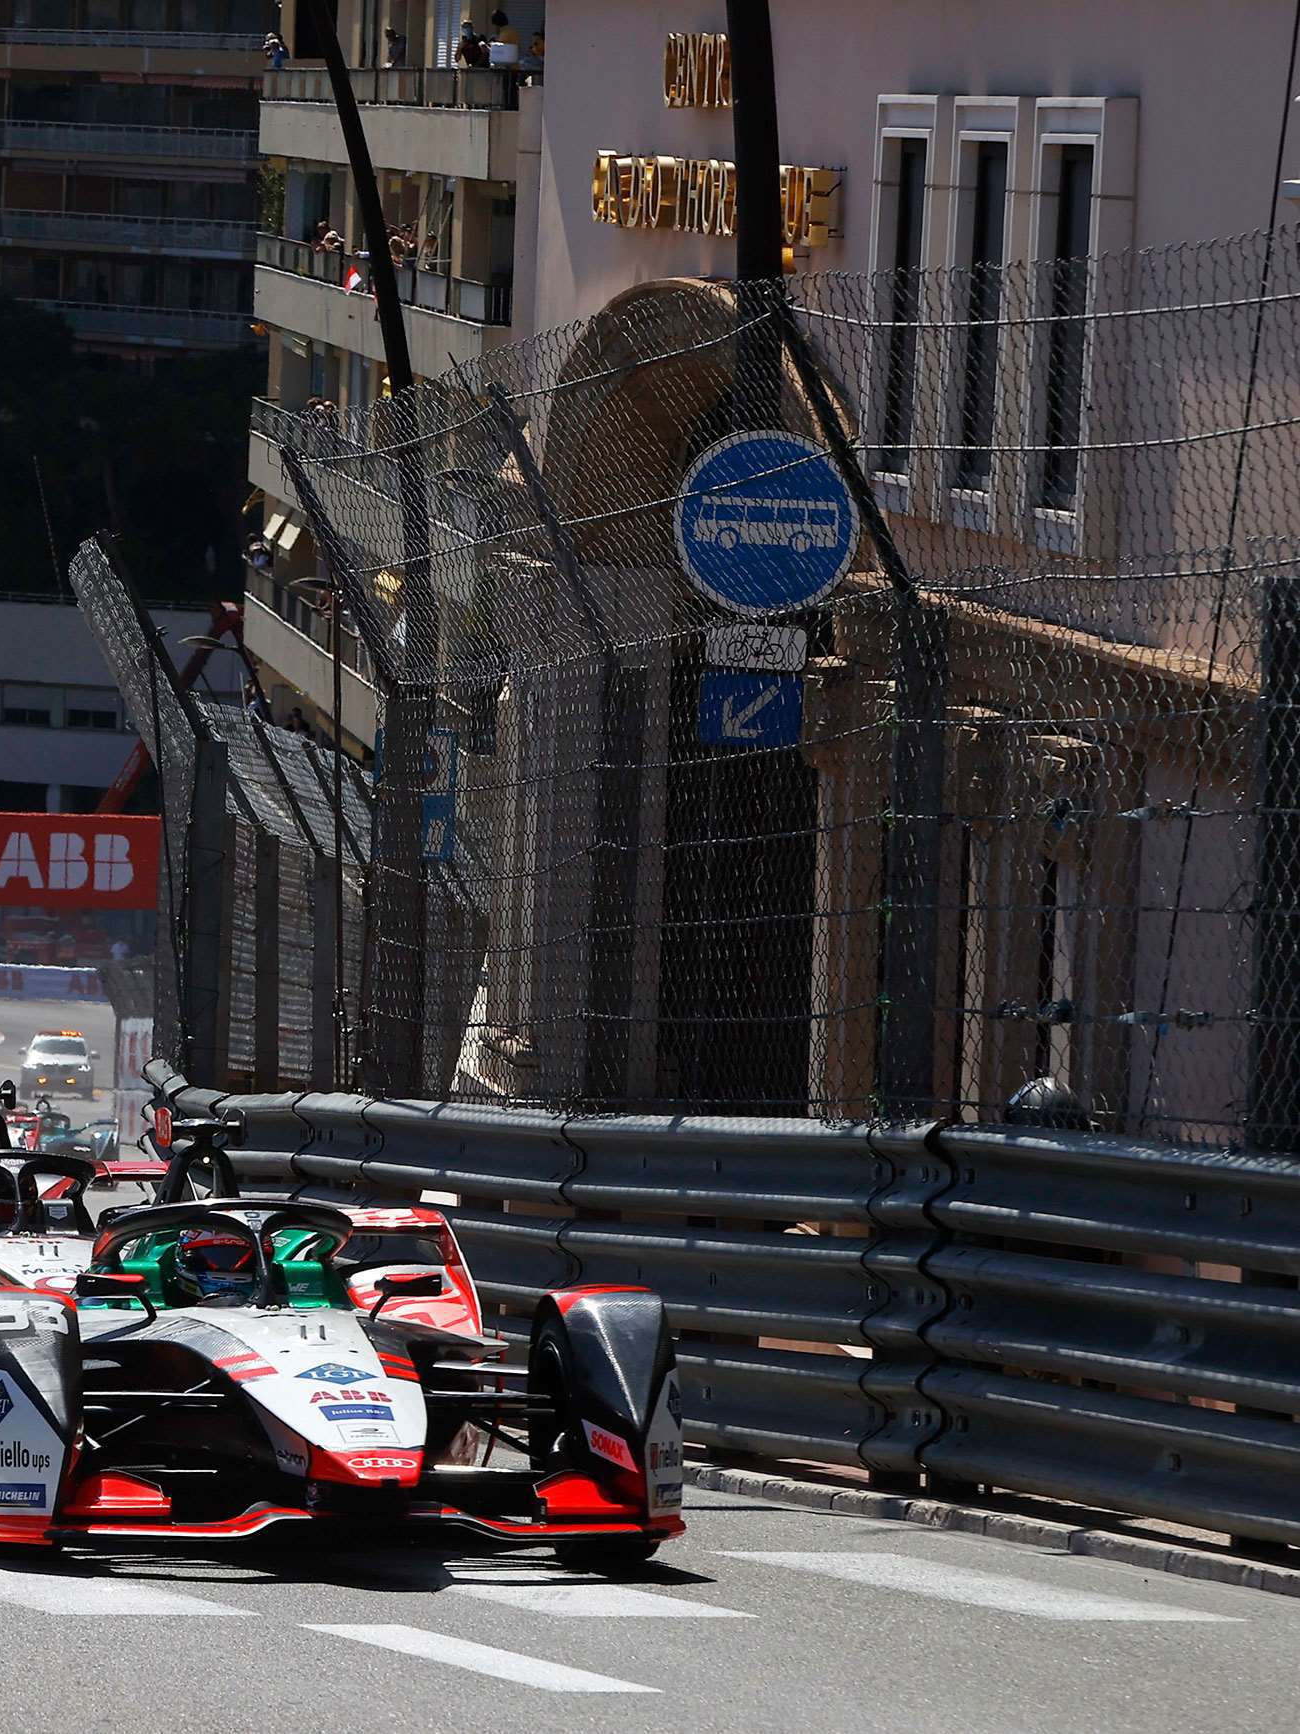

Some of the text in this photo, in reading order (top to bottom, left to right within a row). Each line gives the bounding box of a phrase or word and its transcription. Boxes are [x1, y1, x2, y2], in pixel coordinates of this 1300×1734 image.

[663, 32, 734, 109] CENTR
[22, 1267, 85, 1275] Mobi
[309, 1390, 393, 1404] ABB
[591, 1430, 624, 1462] SONAX
[32, 1454, 51, 1473] ups
